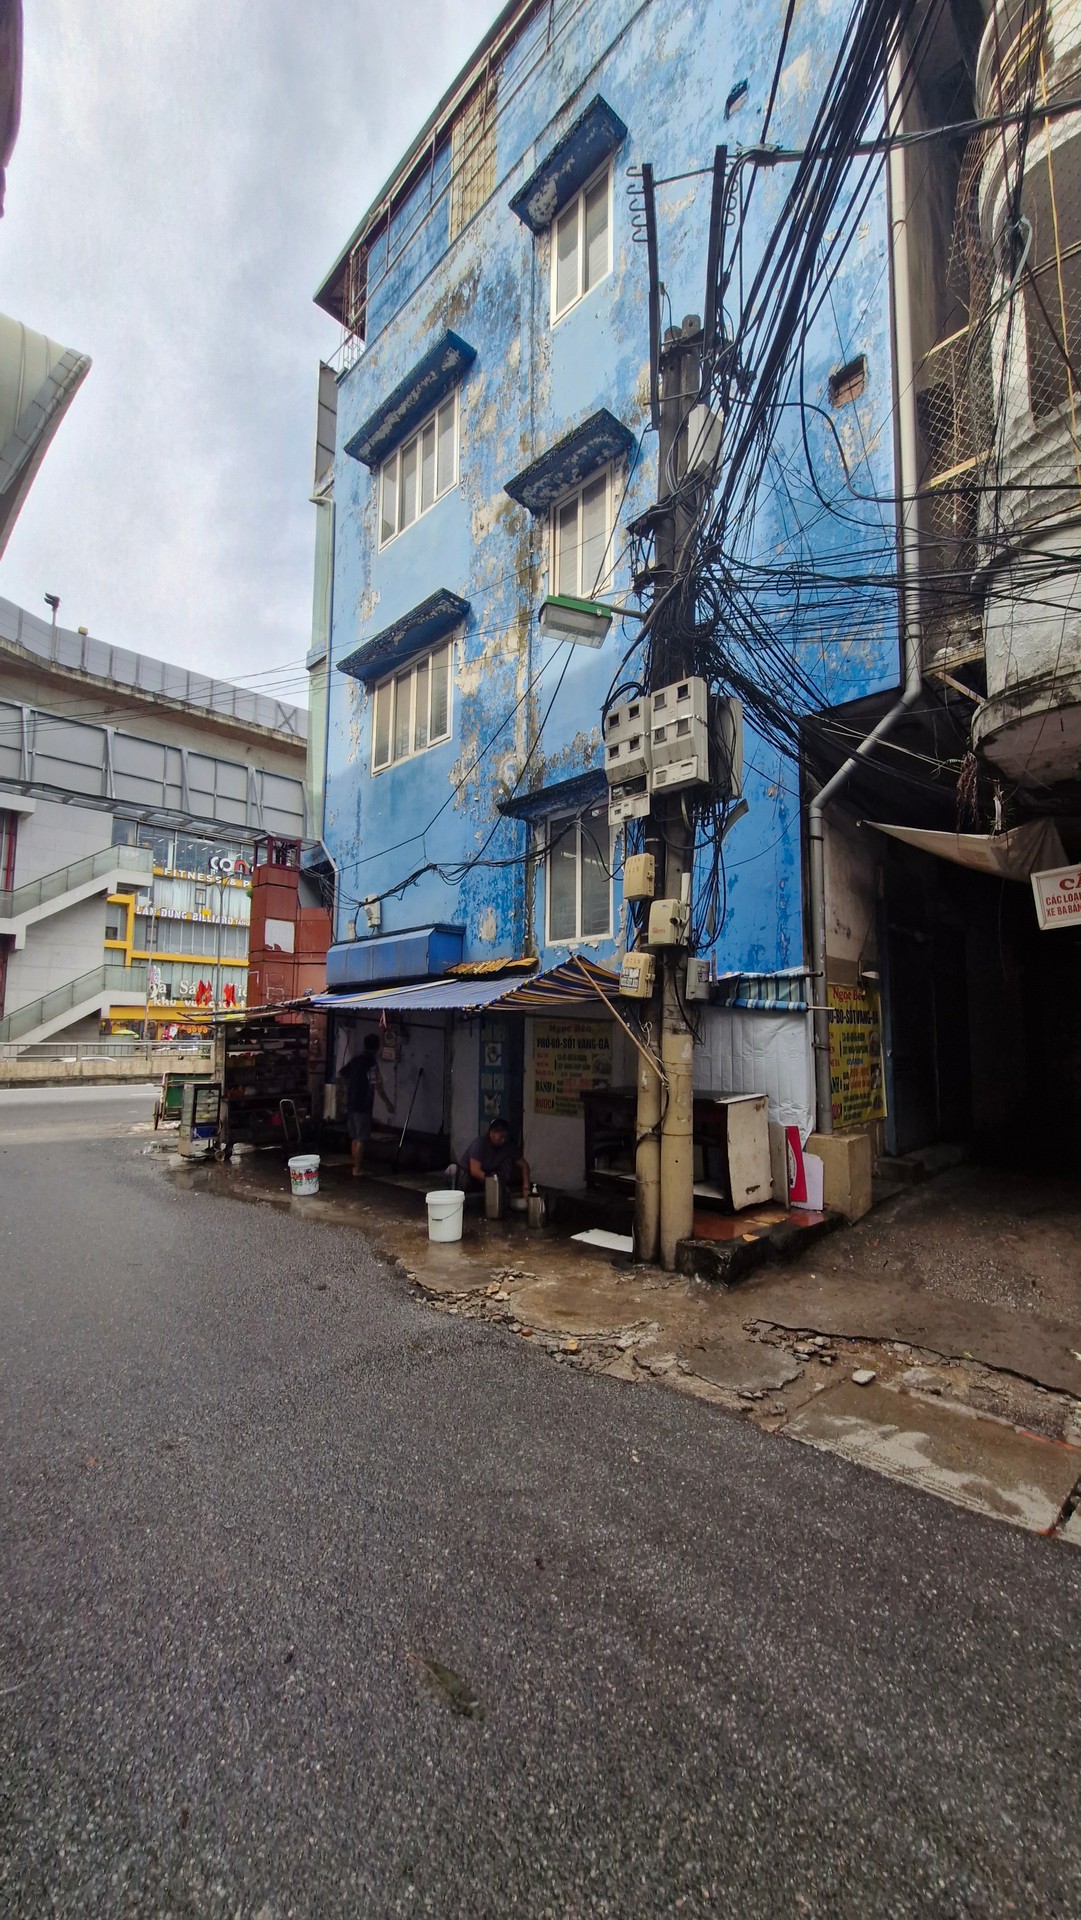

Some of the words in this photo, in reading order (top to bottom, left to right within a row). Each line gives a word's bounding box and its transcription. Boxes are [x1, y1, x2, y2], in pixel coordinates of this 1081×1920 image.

[164, 867, 222, 884] FITNESS
[1046, 907, 1056, 917] XE
[1057, 905, 1068, 916] BA
